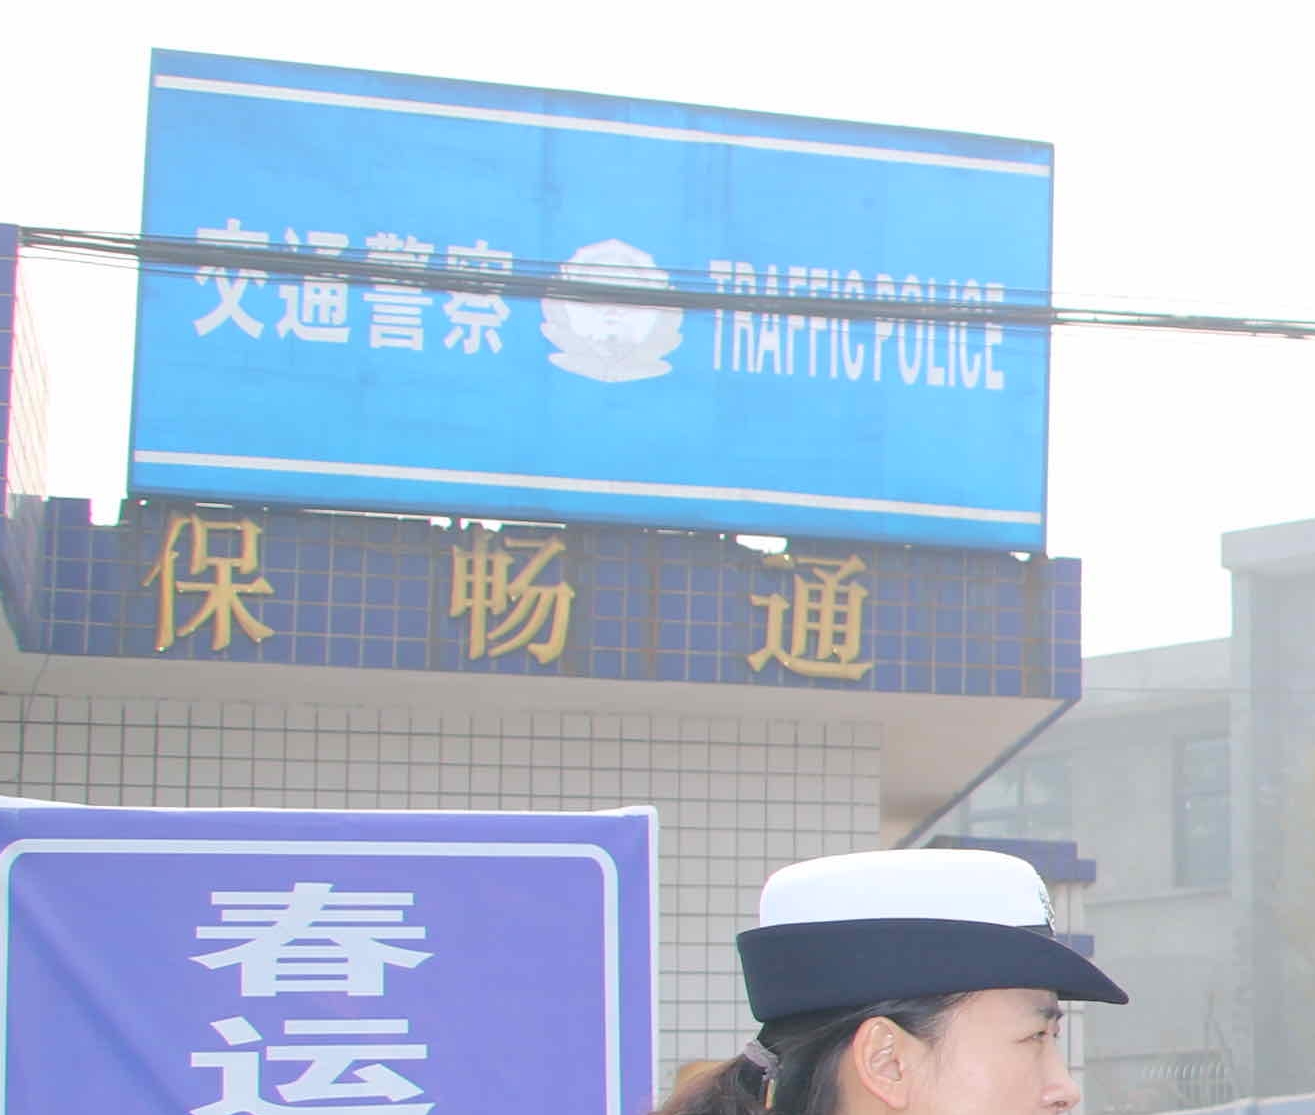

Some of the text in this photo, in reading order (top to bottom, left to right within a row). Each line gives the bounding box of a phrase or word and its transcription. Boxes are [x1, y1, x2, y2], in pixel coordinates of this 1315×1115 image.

[193, 217, 513, 355] 交通警察
[709, 259, 1005, 390] TRAFFIC POLICE
